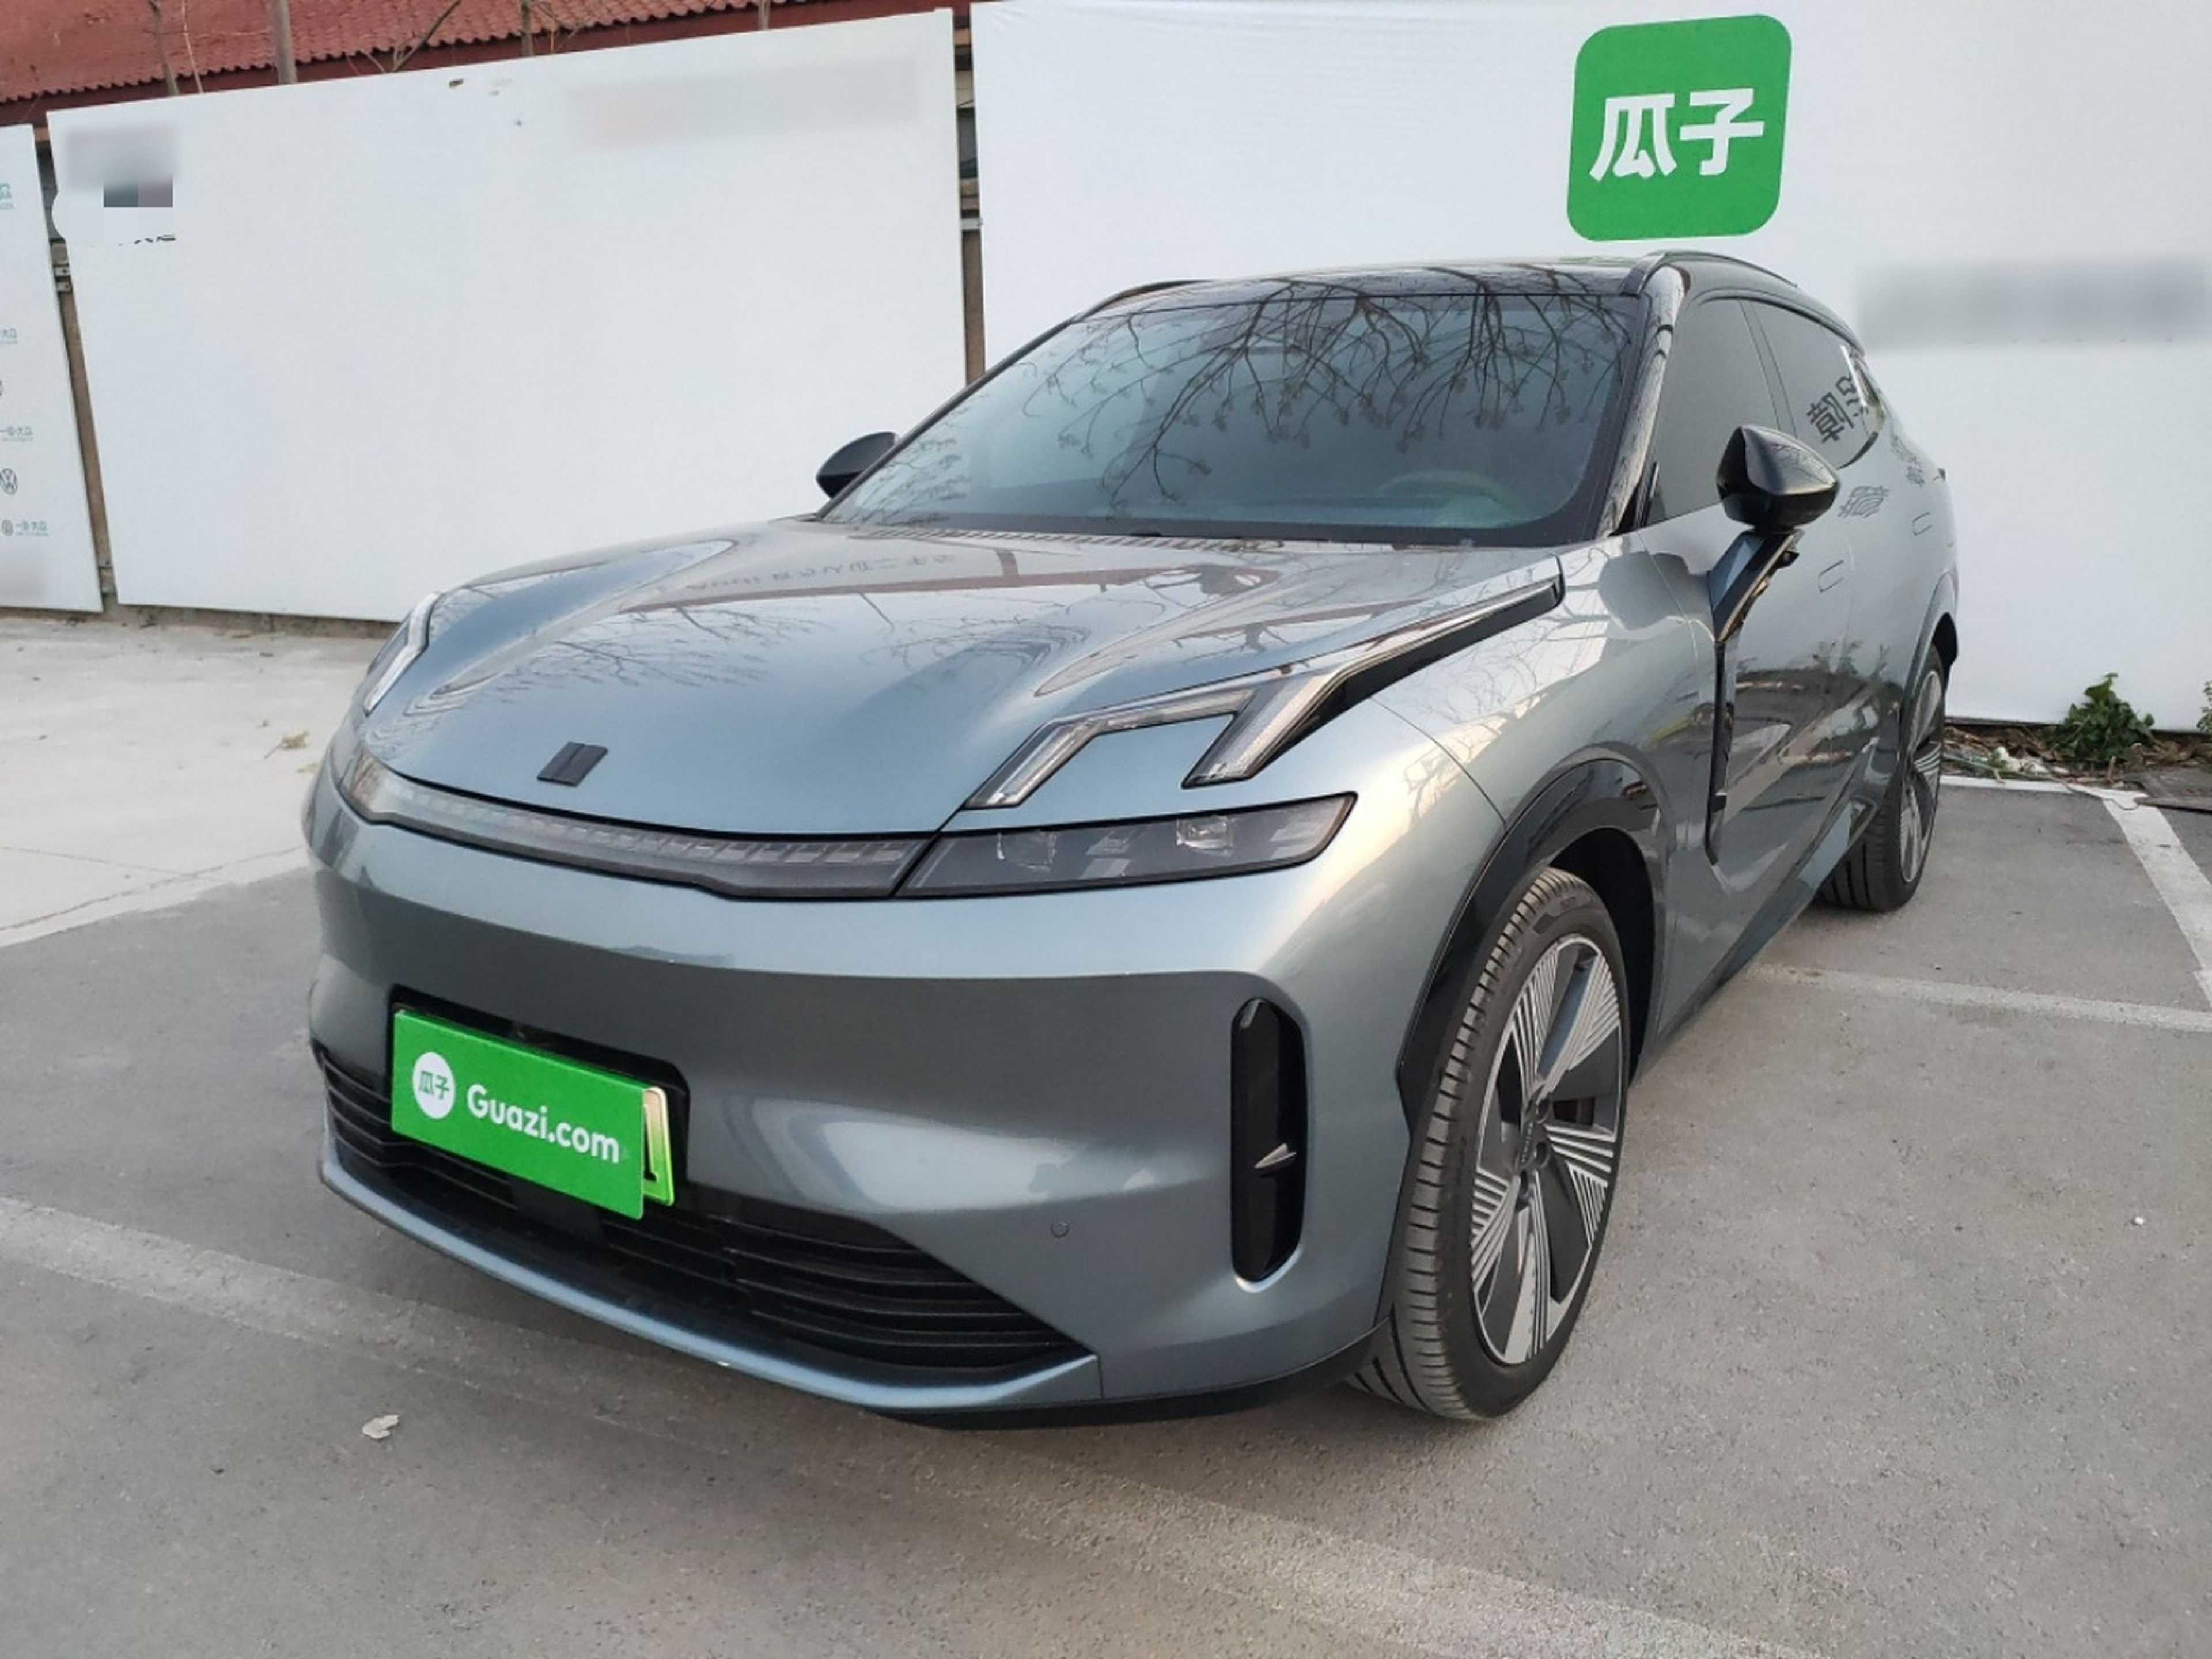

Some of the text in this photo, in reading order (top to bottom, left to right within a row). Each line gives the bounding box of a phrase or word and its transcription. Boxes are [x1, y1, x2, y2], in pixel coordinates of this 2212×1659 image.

[1589, 88, 1765, 182] 瓜子
[418, 1070, 450, 1100] 瓜子
[467, 1084, 619, 1164] Guazi.com
